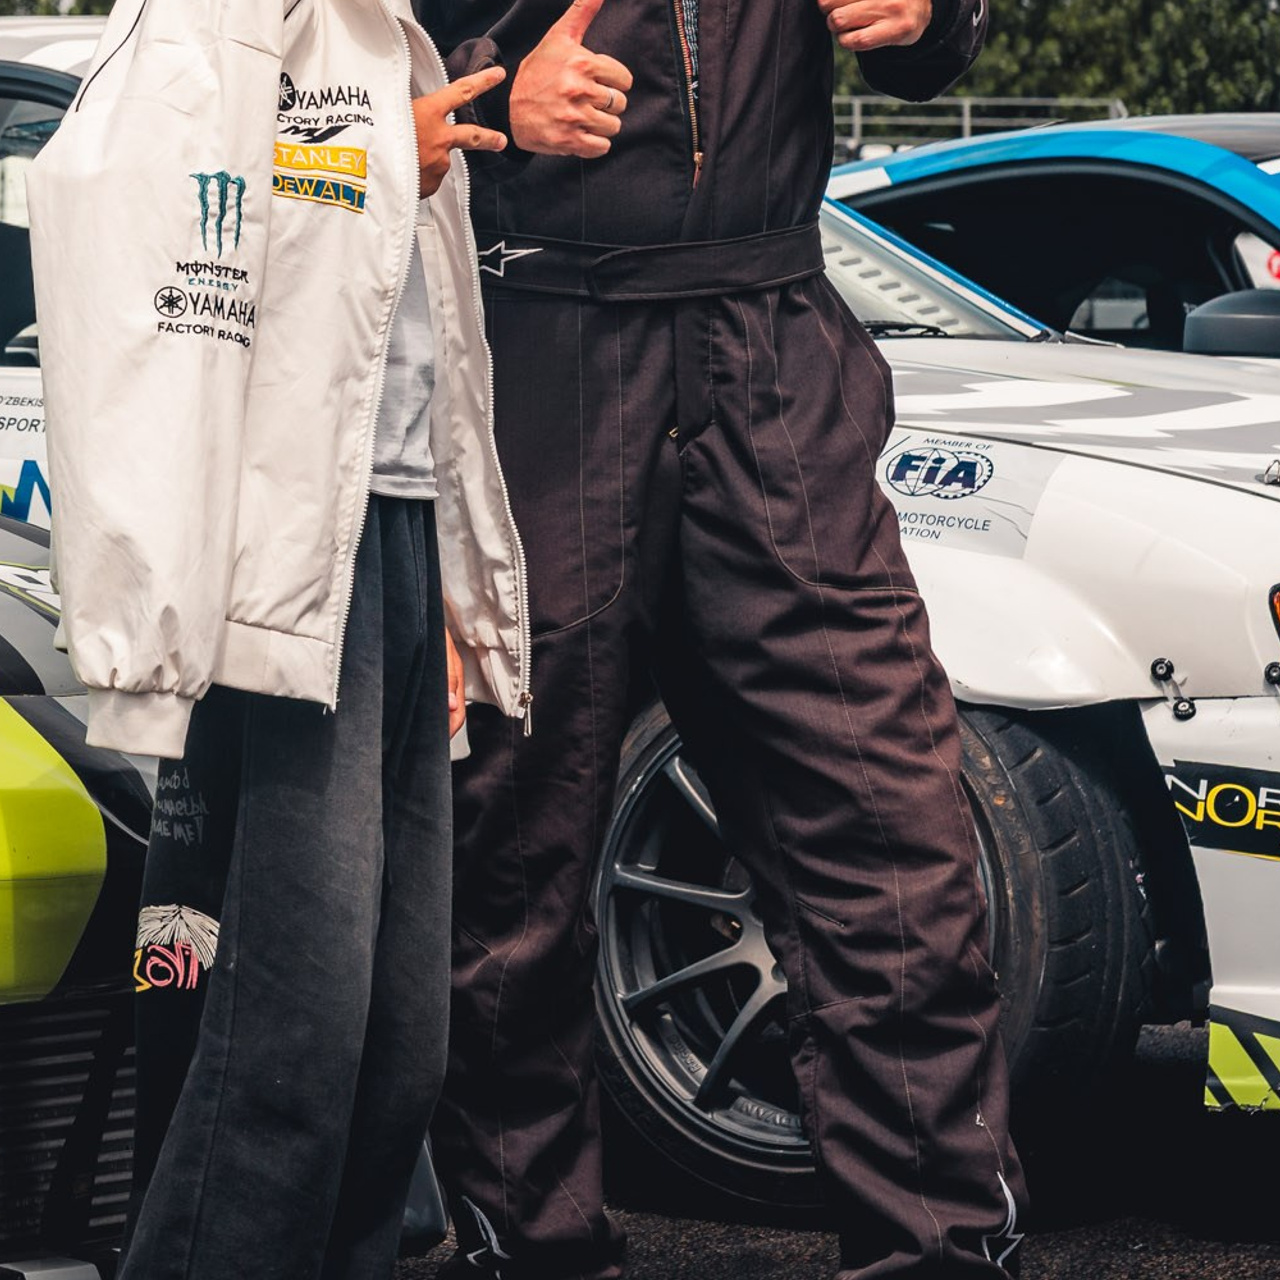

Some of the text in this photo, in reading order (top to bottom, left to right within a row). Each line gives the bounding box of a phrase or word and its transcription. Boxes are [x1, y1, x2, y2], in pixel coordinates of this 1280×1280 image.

[295, 84, 373, 111] YAMAHA
[325, 112, 375, 127] RACING
[176, 260, 249, 284] MONSTER
[188, 277, 238, 291] ENERGY
[189, 292, 256, 329] YAMAHA
[923, 438, 994, 451] MEMBER OF
